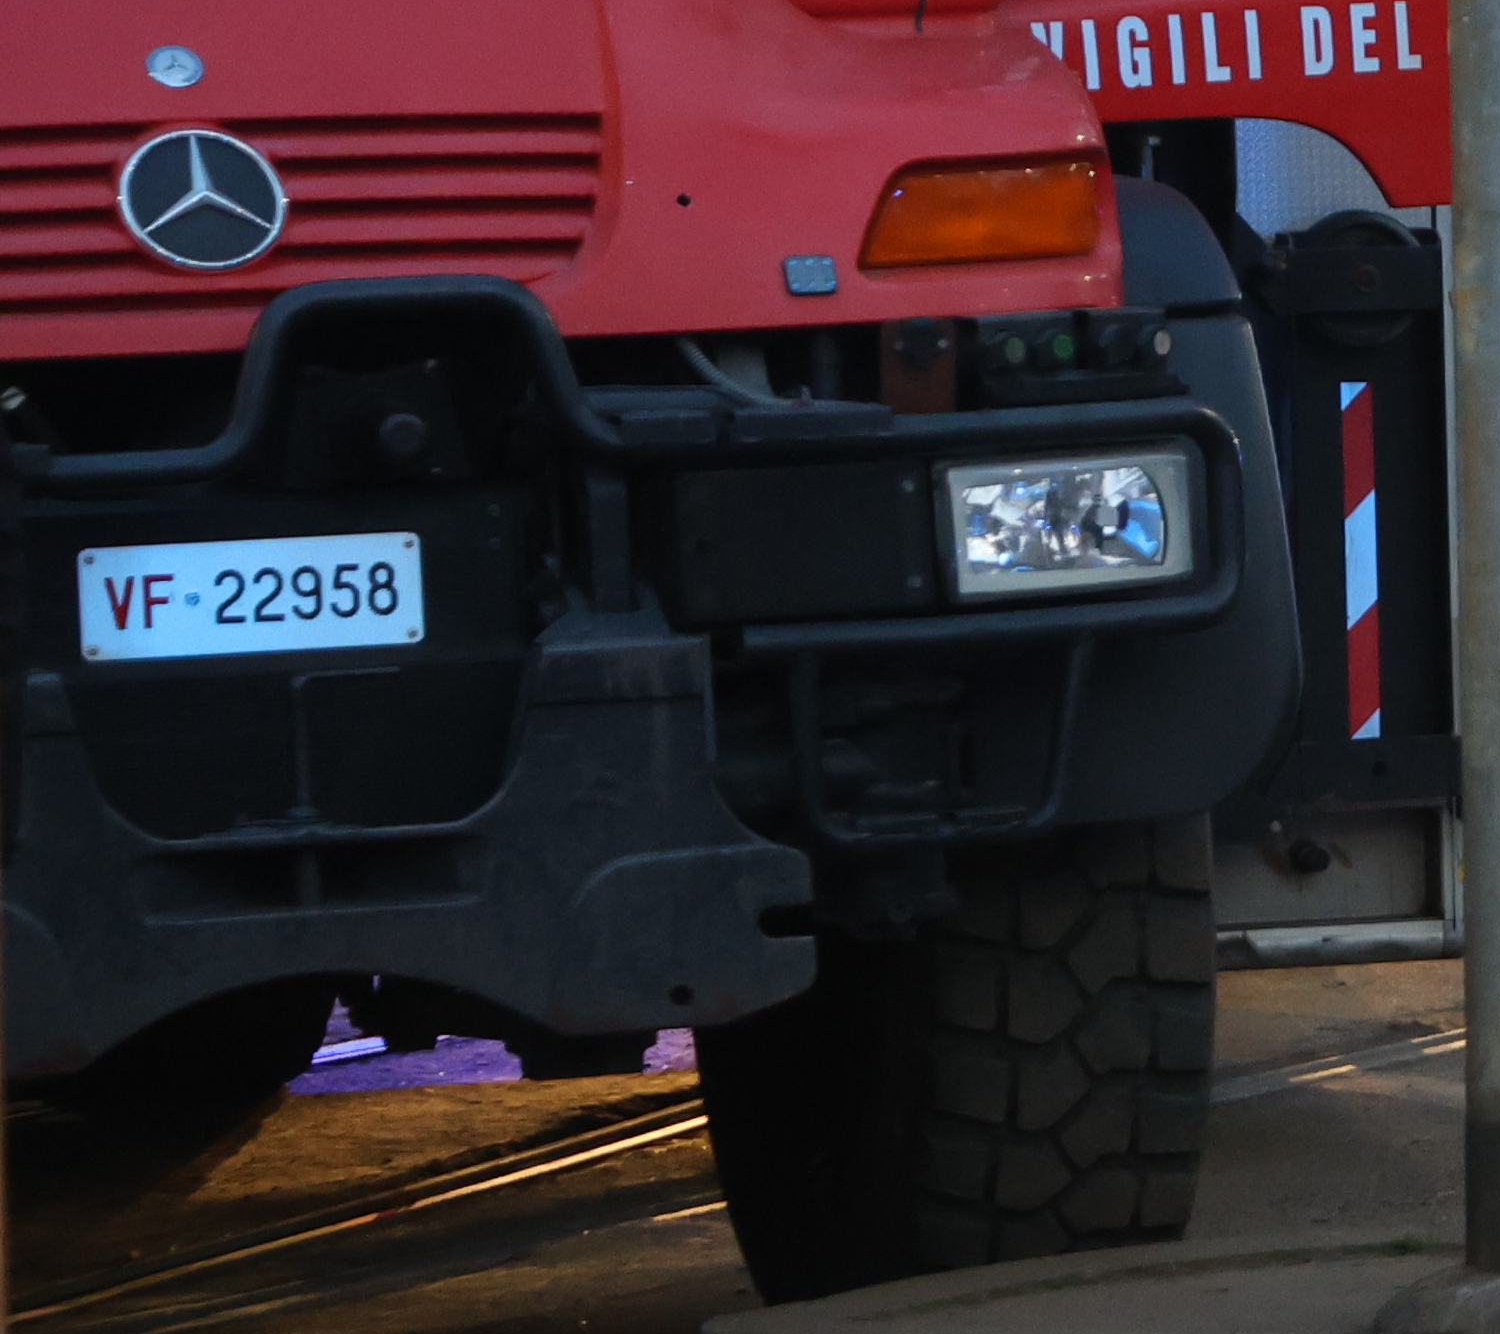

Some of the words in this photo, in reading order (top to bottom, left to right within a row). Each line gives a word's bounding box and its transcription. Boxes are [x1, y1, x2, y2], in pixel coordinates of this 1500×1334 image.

[1300, 0, 1423, 77] DEL
[104, 572, 175, 630] VF
[213, 561, 400, 625] 22958
